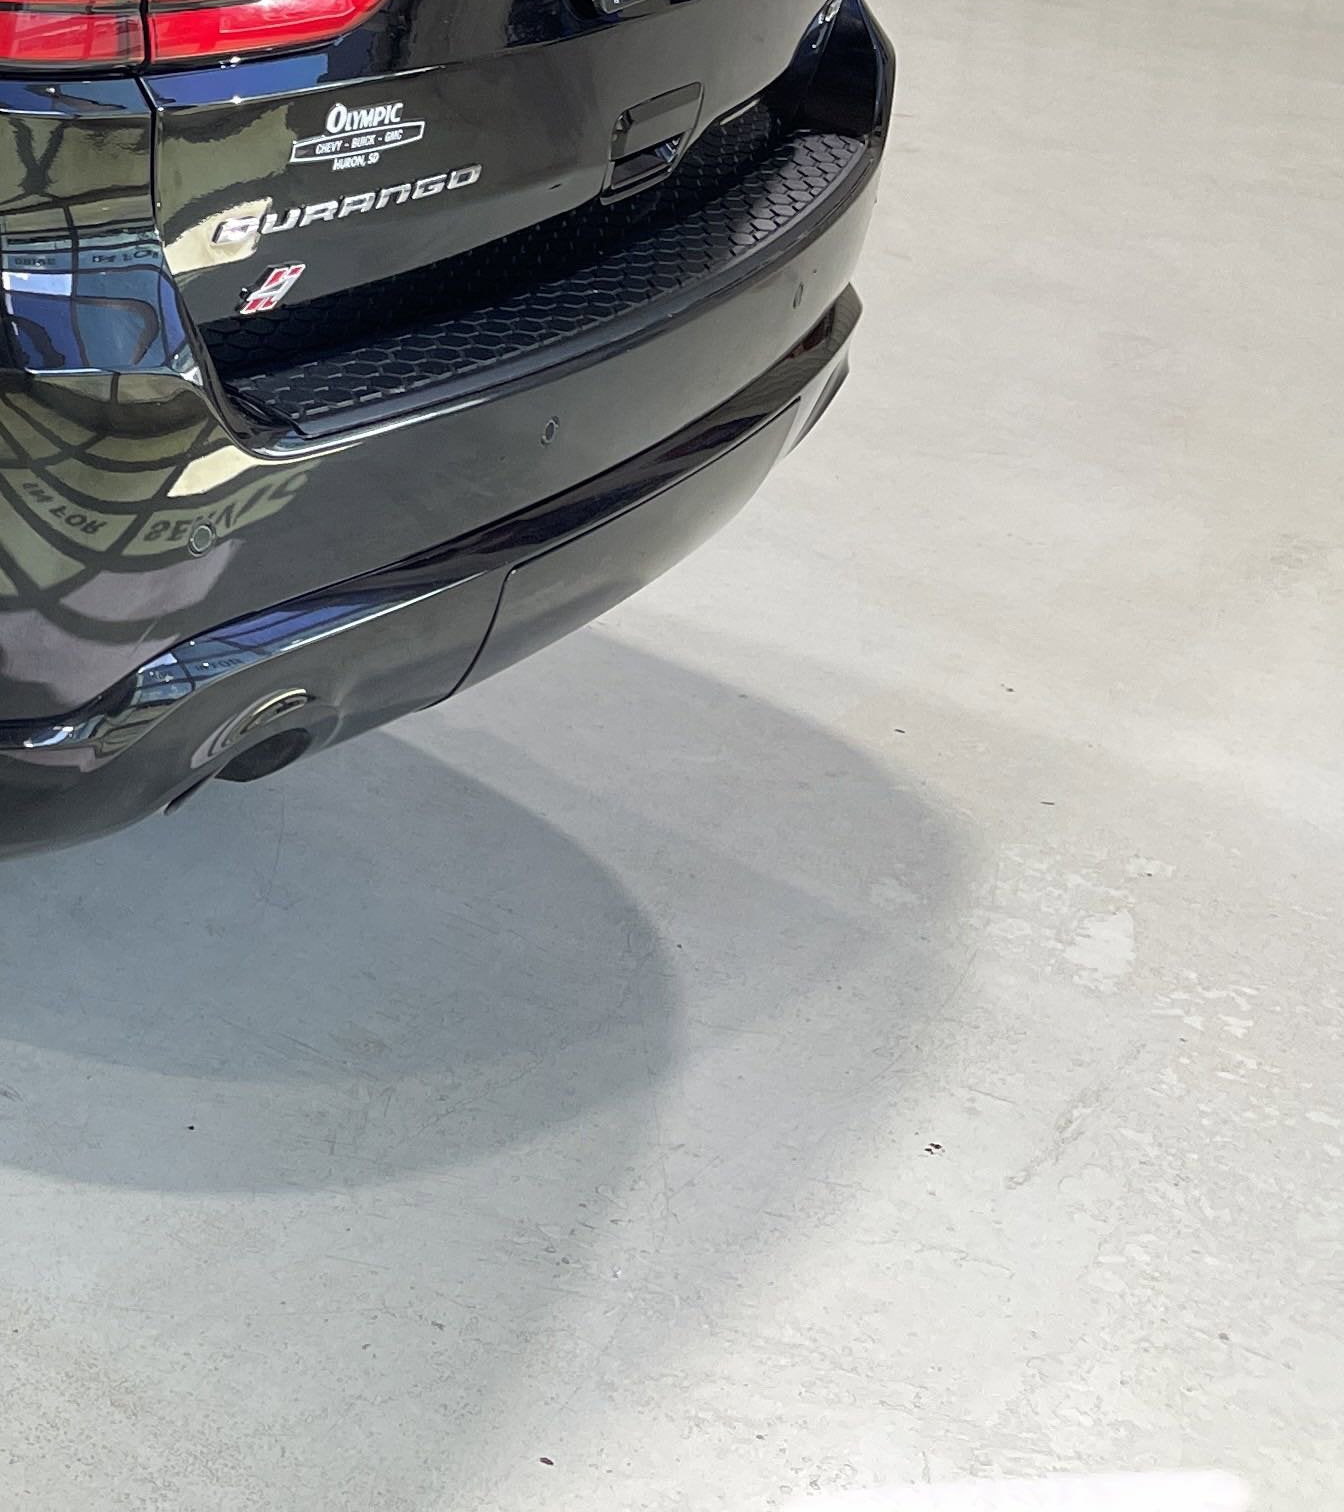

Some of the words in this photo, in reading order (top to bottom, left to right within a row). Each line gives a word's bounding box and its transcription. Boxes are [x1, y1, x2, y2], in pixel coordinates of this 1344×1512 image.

[326, 102, 404, 134] OLYMPIC
[315, 139, 343, 155] CHEVY
[351, 134, 376, 149] BUICK
[384, 129, 403, 142] GMC
[332, 154, 366, 170] HURON,
[213, 164, 482, 245] DURANGO
